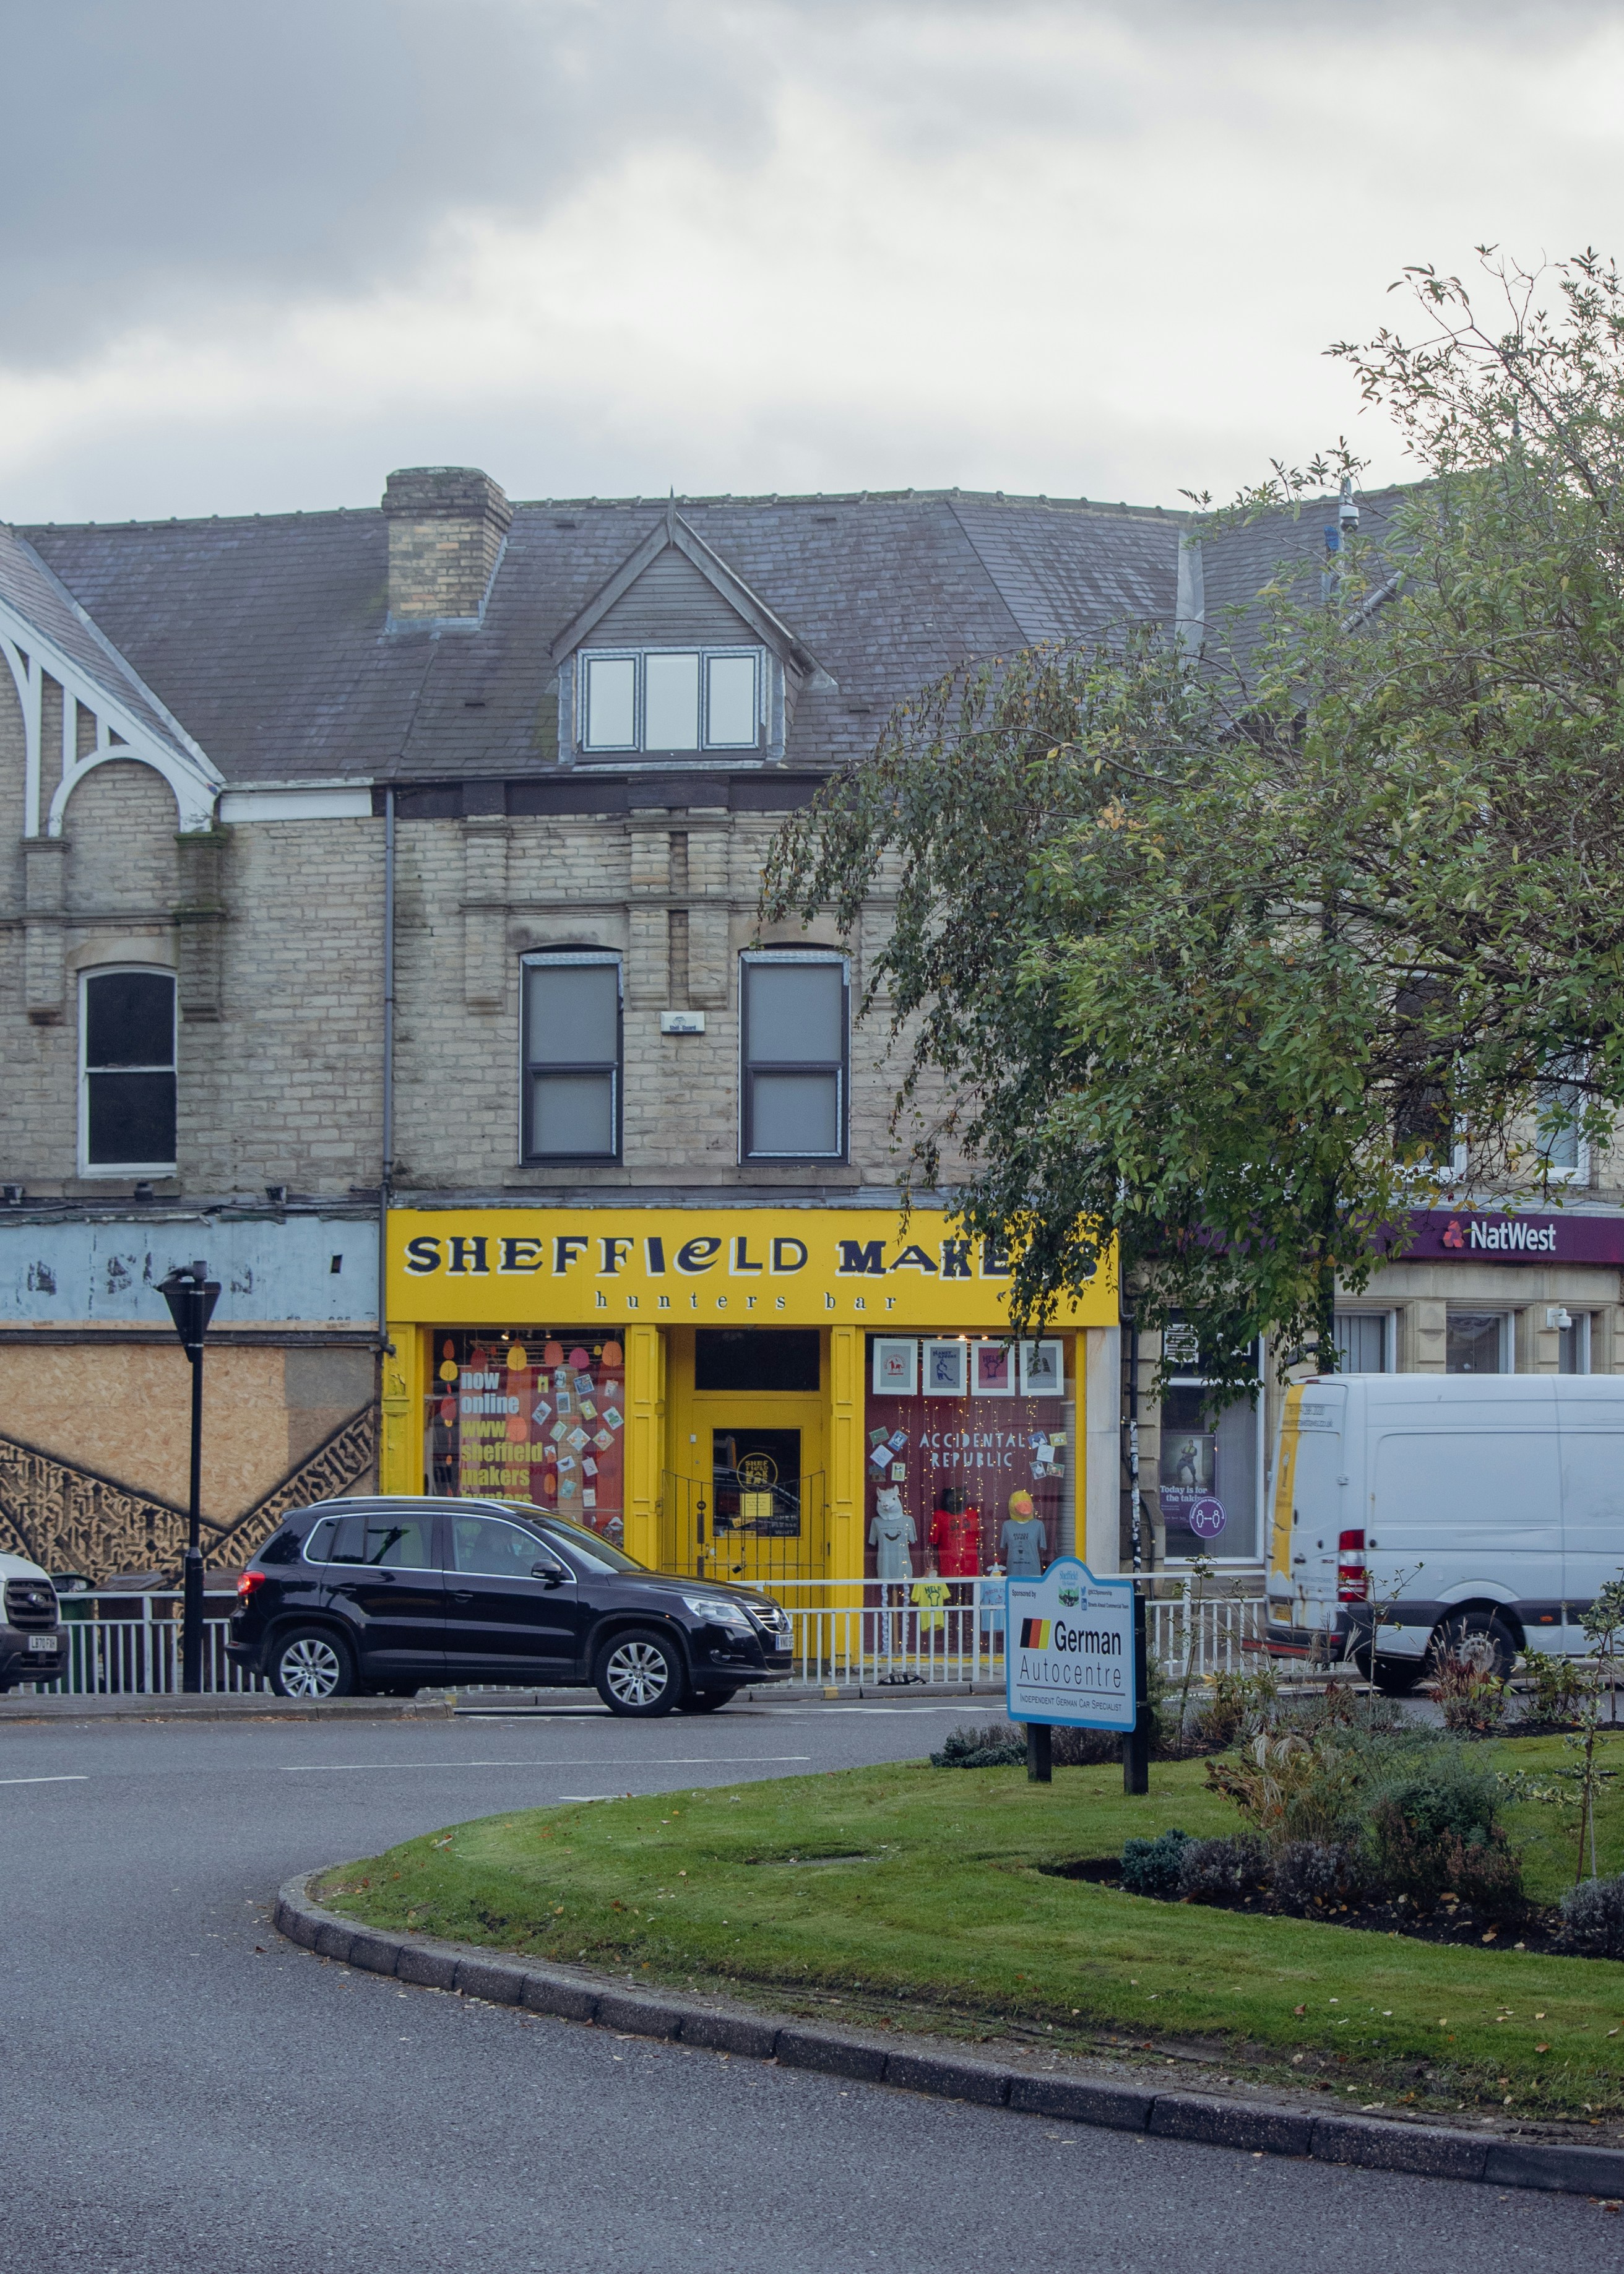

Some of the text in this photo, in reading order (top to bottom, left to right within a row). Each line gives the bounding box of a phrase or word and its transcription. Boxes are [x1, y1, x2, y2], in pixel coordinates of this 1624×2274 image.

[1471, 1221, 1556, 1251] NatWest
[595, 1290, 896, 1312] hunters bar
[460, 1372, 499, 1390] now
[460, 1393, 519, 1414] online
[919, 1432, 1025, 1448] ACCIDENTAL
[460, 1442, 543, 1462] sheffield
[931, 1452, 1013, 1468] REPUBLIC
[461, 1465, 530, 1486] makers
[1160, 1485, 1185, 1495] Today
[925, 1586, 942, 1594] HELP
[1012, 1589, 1032, 1597] Sponsored
[1032, 1591, 1036, 1599] by
[1054, 1620, 1121, 1656] German
[1020, 1654, 1121, 1688] Autocentre
[1020, 1693, 1122, 1712] INDEPENDENT GERMAN CAR SPECIALIST
